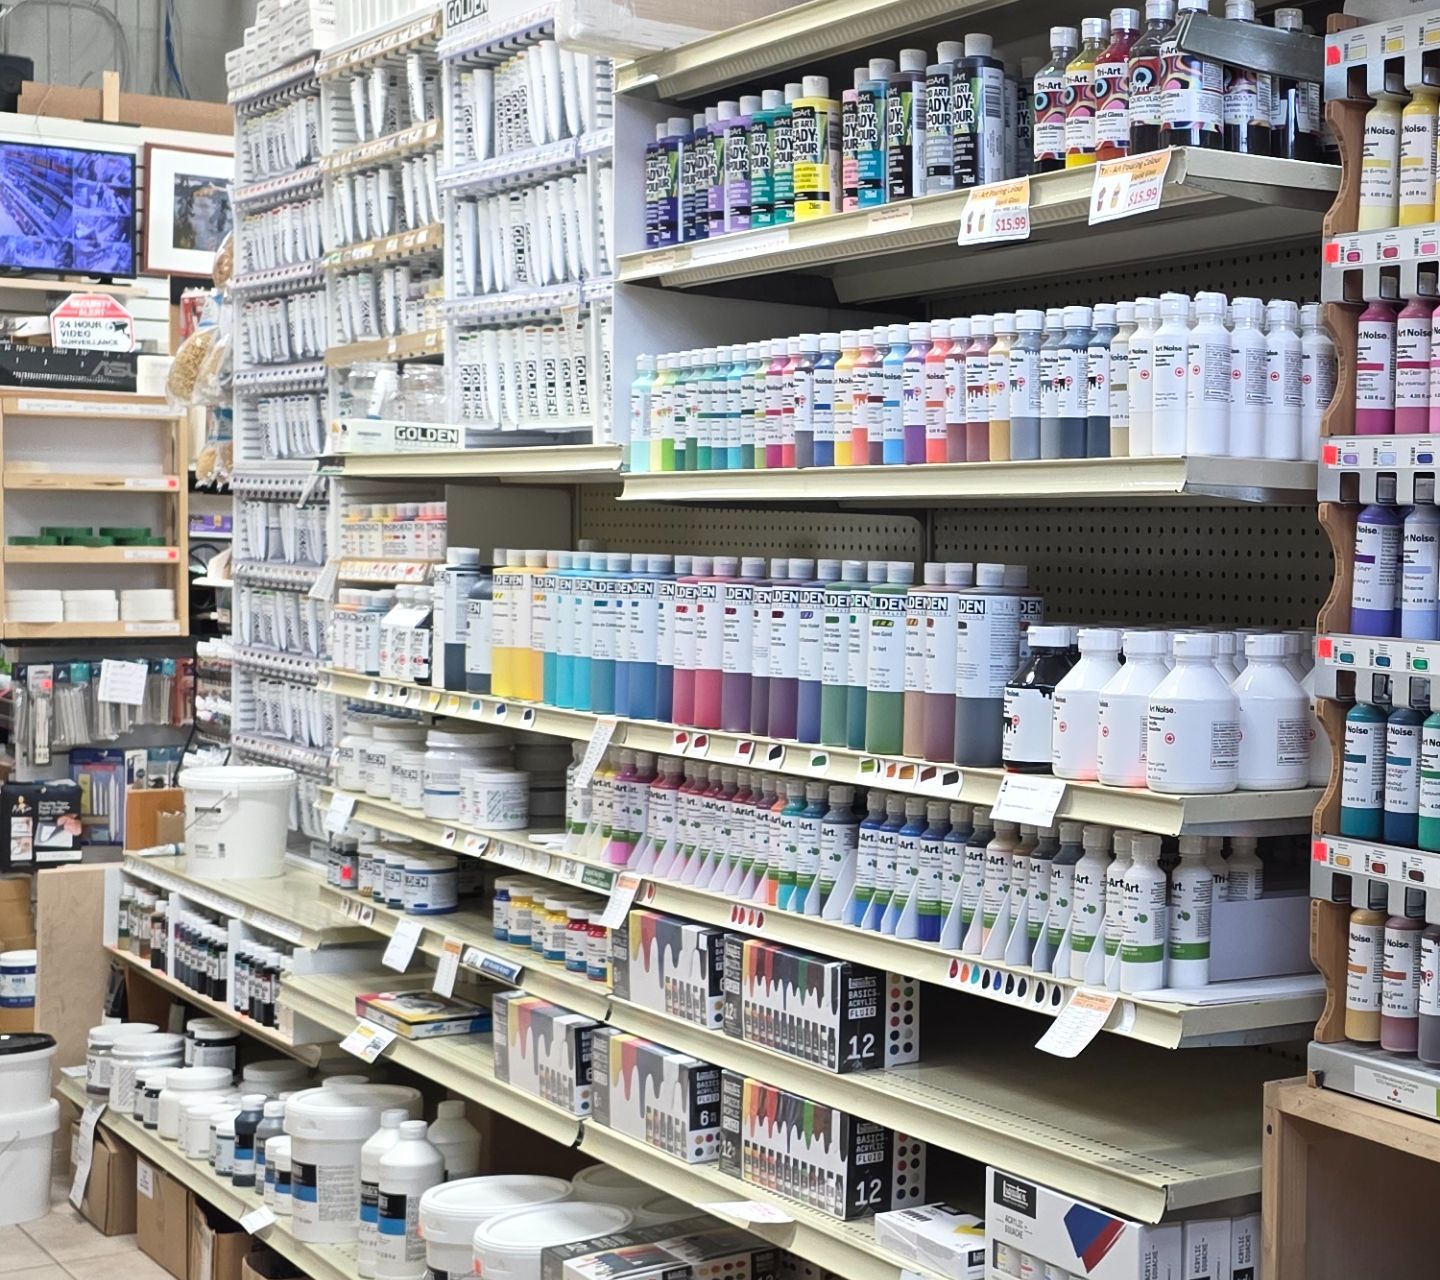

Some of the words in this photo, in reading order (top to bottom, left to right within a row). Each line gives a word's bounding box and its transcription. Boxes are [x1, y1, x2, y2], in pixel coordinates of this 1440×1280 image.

[1127, 187, 1157, 207] $15.99
[996, 217, 1025, 232] $15.99
[395, 427, 459, 443] GOLDEN
[848, 1033, 875, 1060] 12
[855, 1179, 882, 1205] 12
